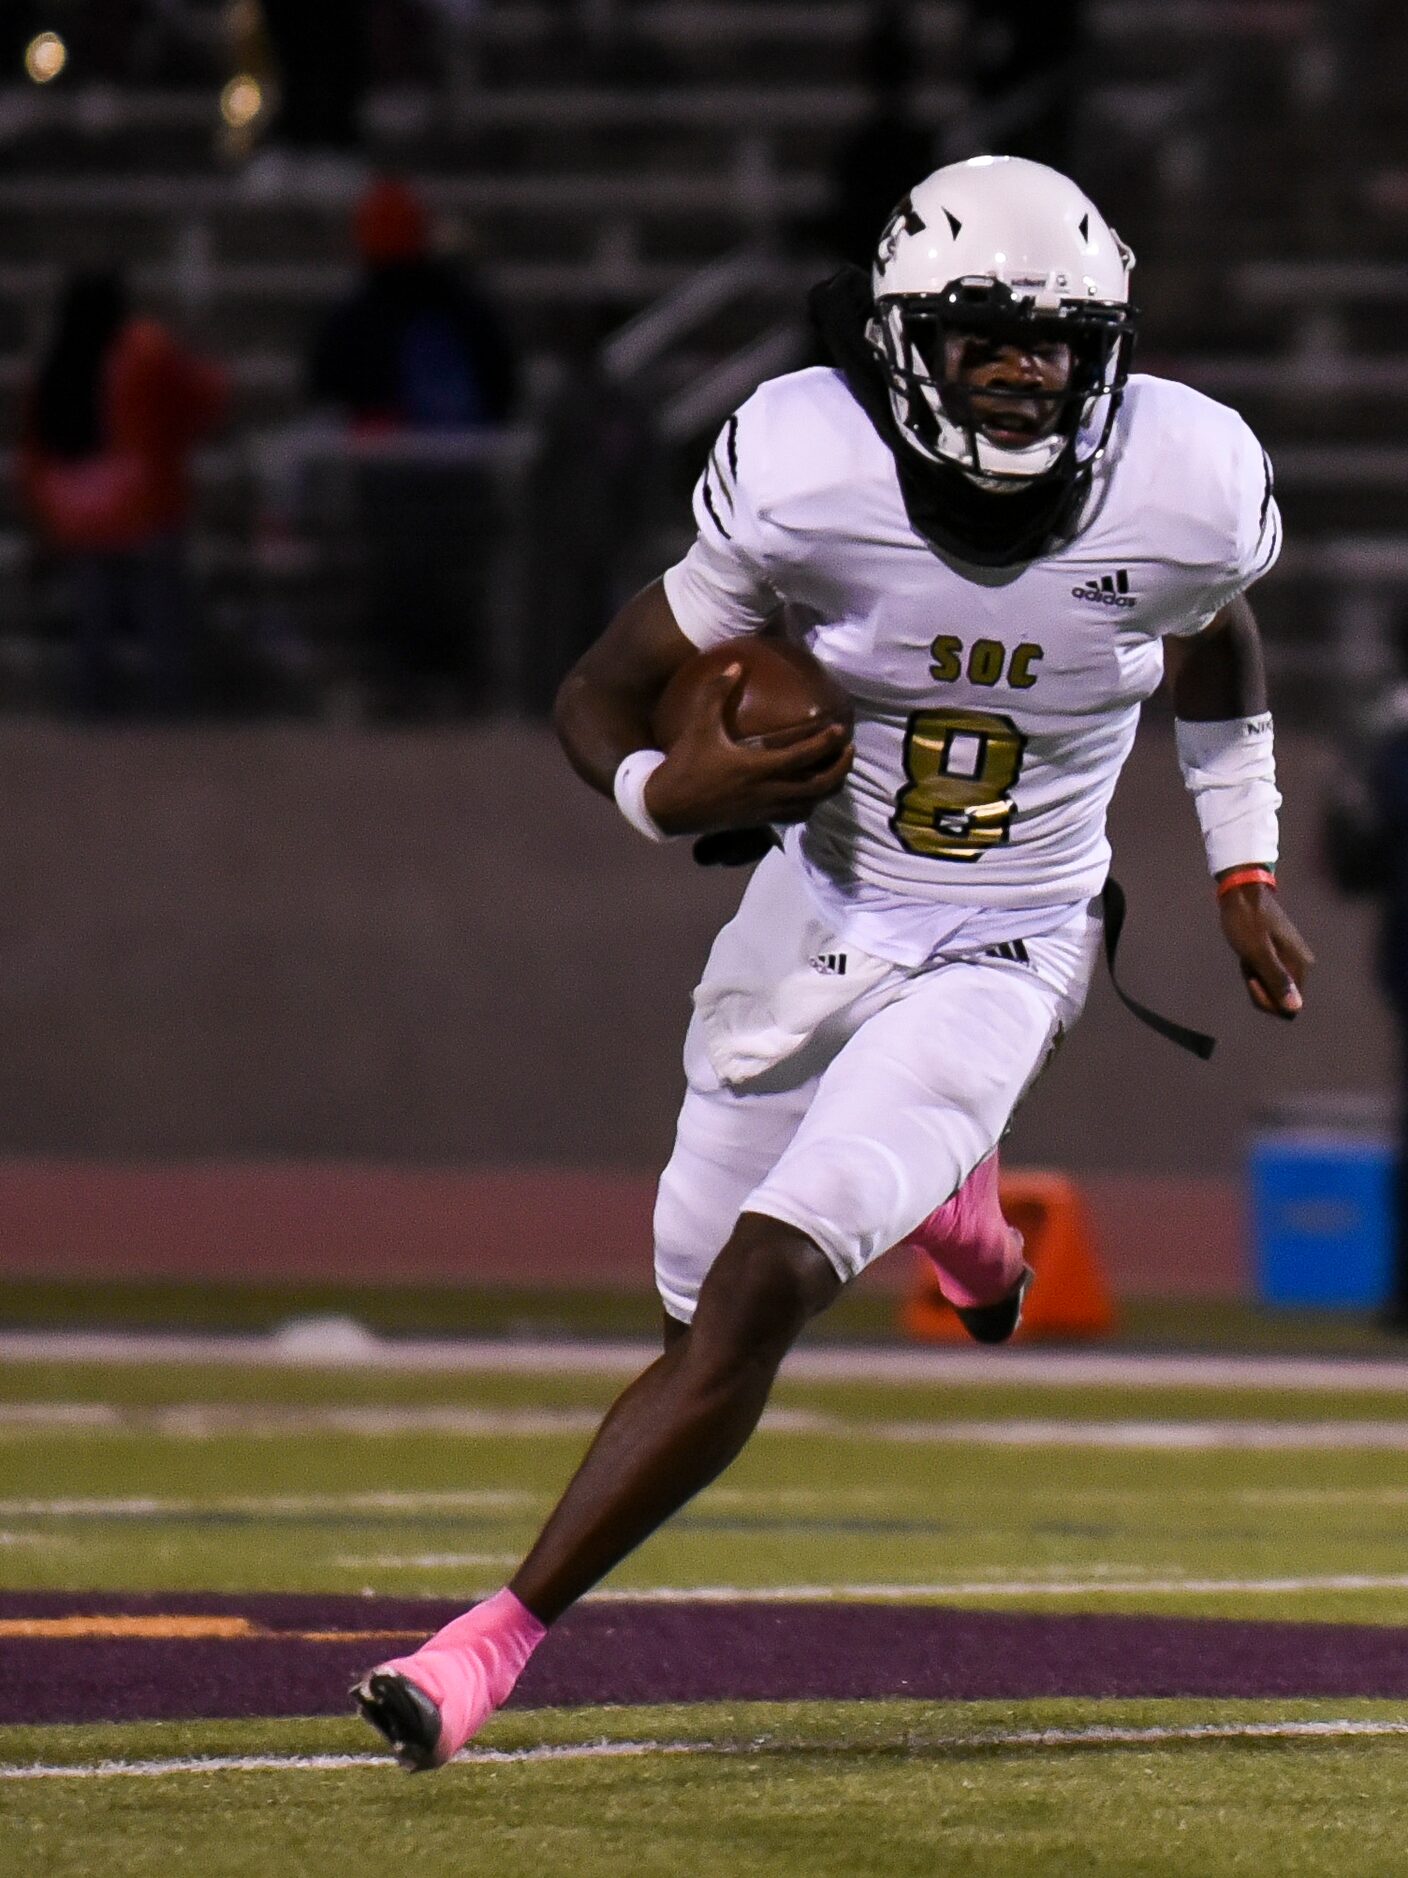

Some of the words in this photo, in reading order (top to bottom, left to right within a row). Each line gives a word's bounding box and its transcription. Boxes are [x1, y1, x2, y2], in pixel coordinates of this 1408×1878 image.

[1071, 586, 1137, 607] adidas
[929, 634, 1044, 689] SOC
[888, 708, 1028, 863] 8
